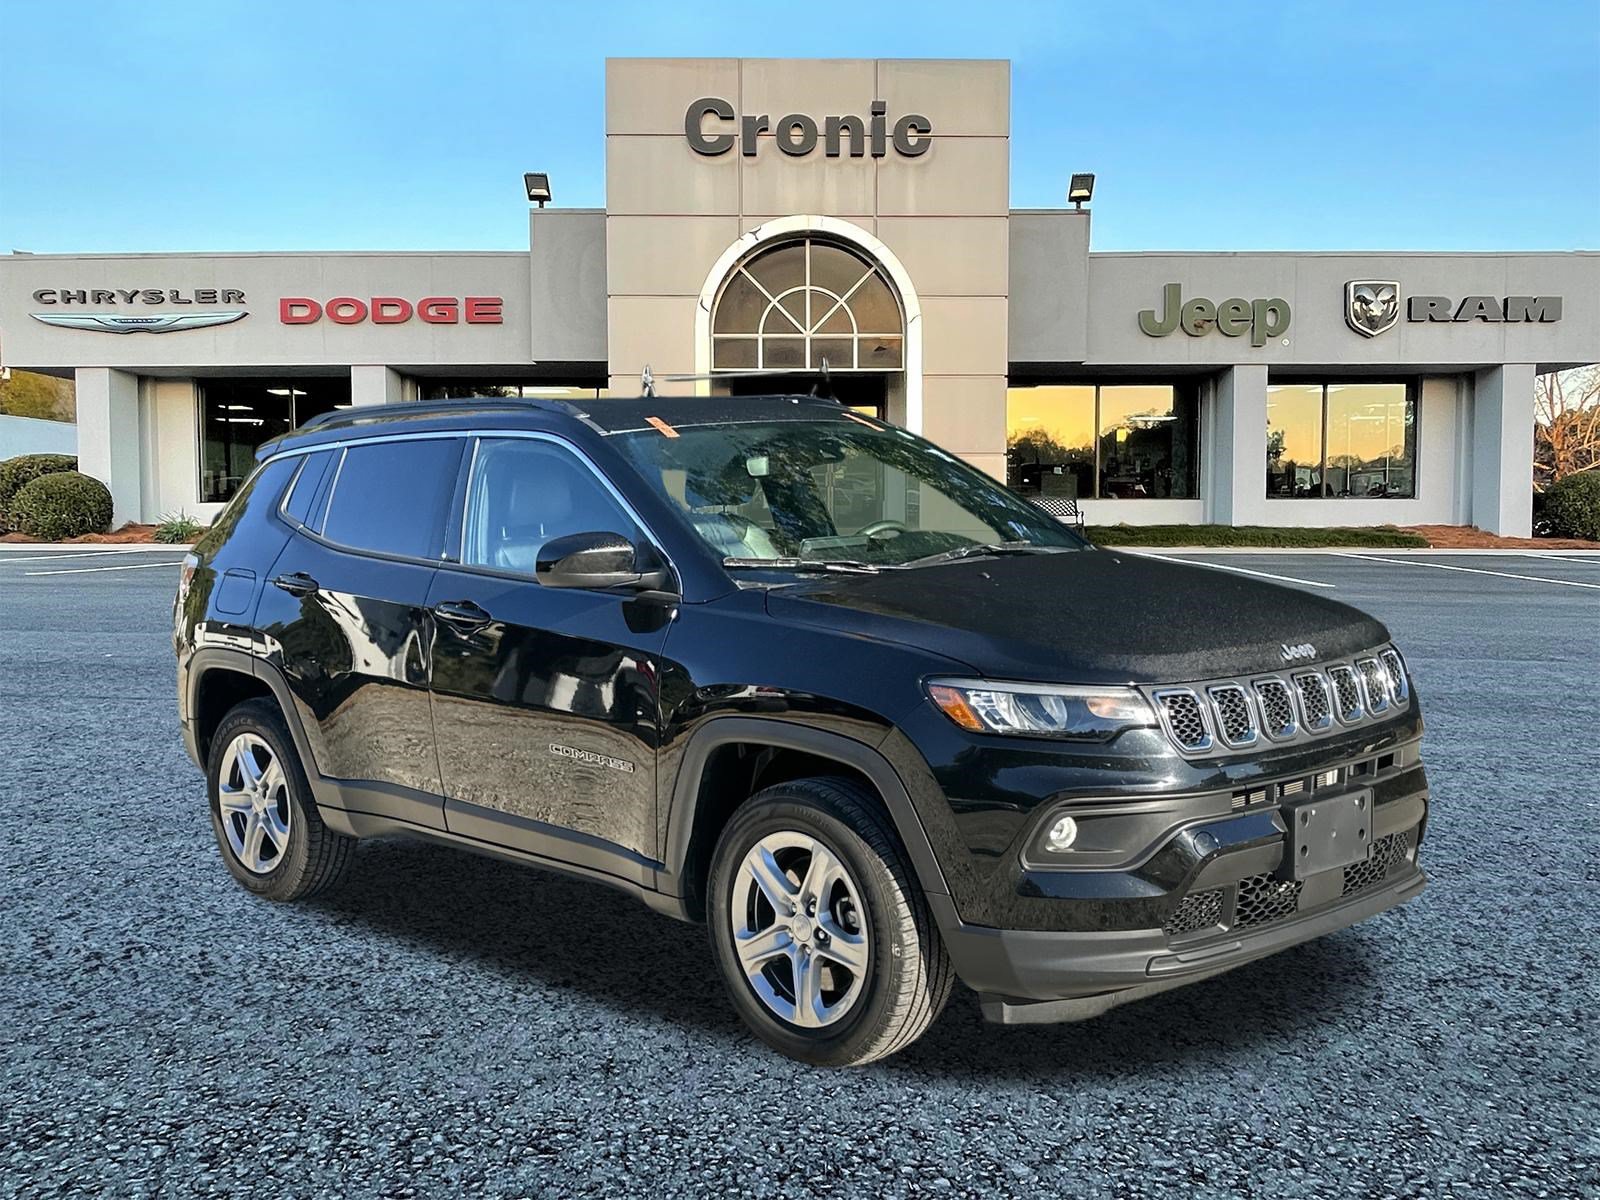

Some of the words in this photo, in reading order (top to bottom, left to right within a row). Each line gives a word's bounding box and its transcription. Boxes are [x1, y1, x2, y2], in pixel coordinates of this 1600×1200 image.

[685, 97, 932, 158] Cronic
[32, 288, 247, 305] CHRYSLER
[1407, 296, 1562, 322] RAM
[279, 297, 504, 325] DODGE
[1138, 283, 1291, 348] Jeep
[1280, 643, 1317, 661] Jeep
[548, 743, 635, 774] COMPASS
